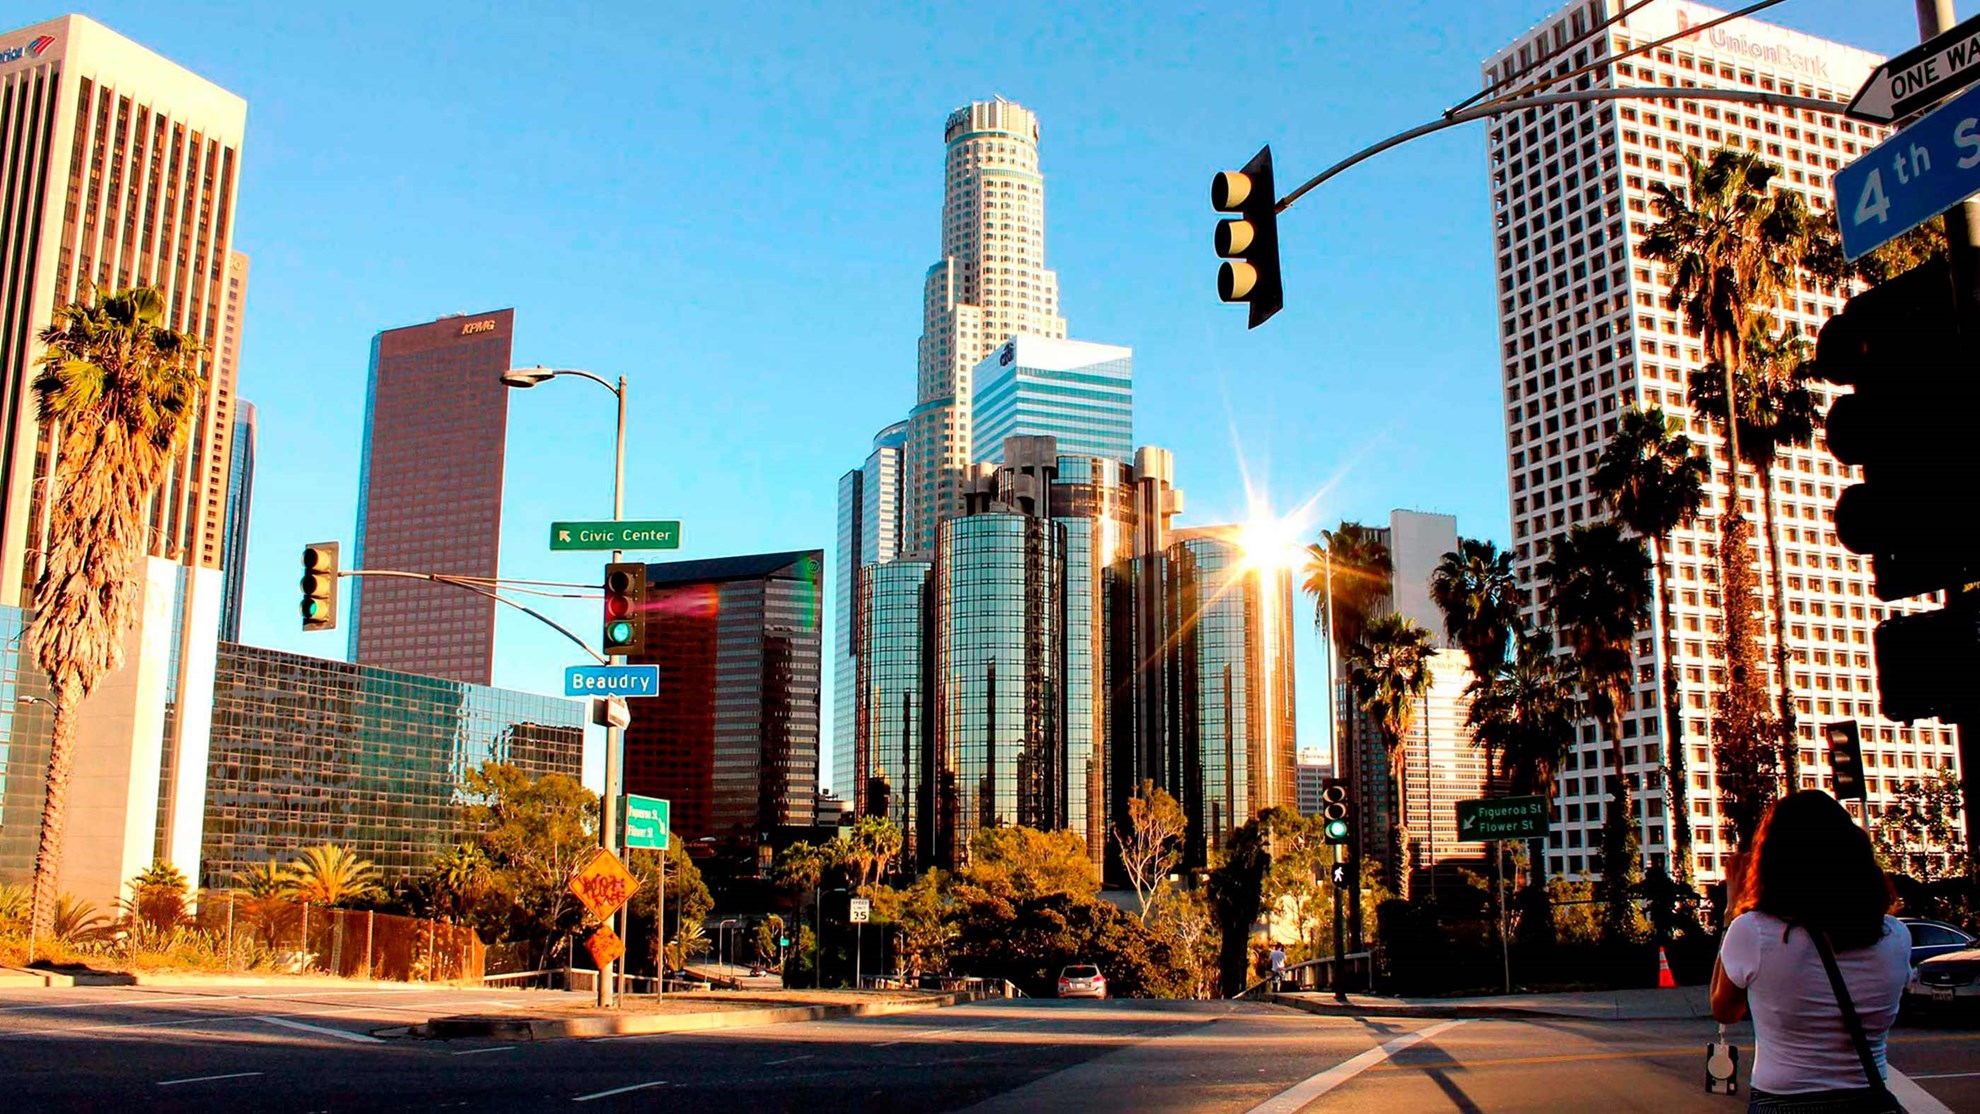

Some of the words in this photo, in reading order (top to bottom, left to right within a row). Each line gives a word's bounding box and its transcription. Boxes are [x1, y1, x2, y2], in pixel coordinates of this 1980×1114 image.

[1709, 25, 1828, 78] UnionBank
[1891, 57, 1941, 100] ONE
[1946, 34, 1980, 74] WA
[1854, 143, 1931, 227] 4th
[1953, 117, 1980, 169] S
[462, 320, 495, 335] KPMG
[580, 530, 614, 542] Civic
[622, 529, 671, 541] Center
[572, 673, 650, 692] Beaudry
[1478, 806, 1527, 820] Figueroa
[1530, 804, 1541, 814] St
[1480, 822, 1518, 832] Flower
[1522, 820, 1534, 830] St
